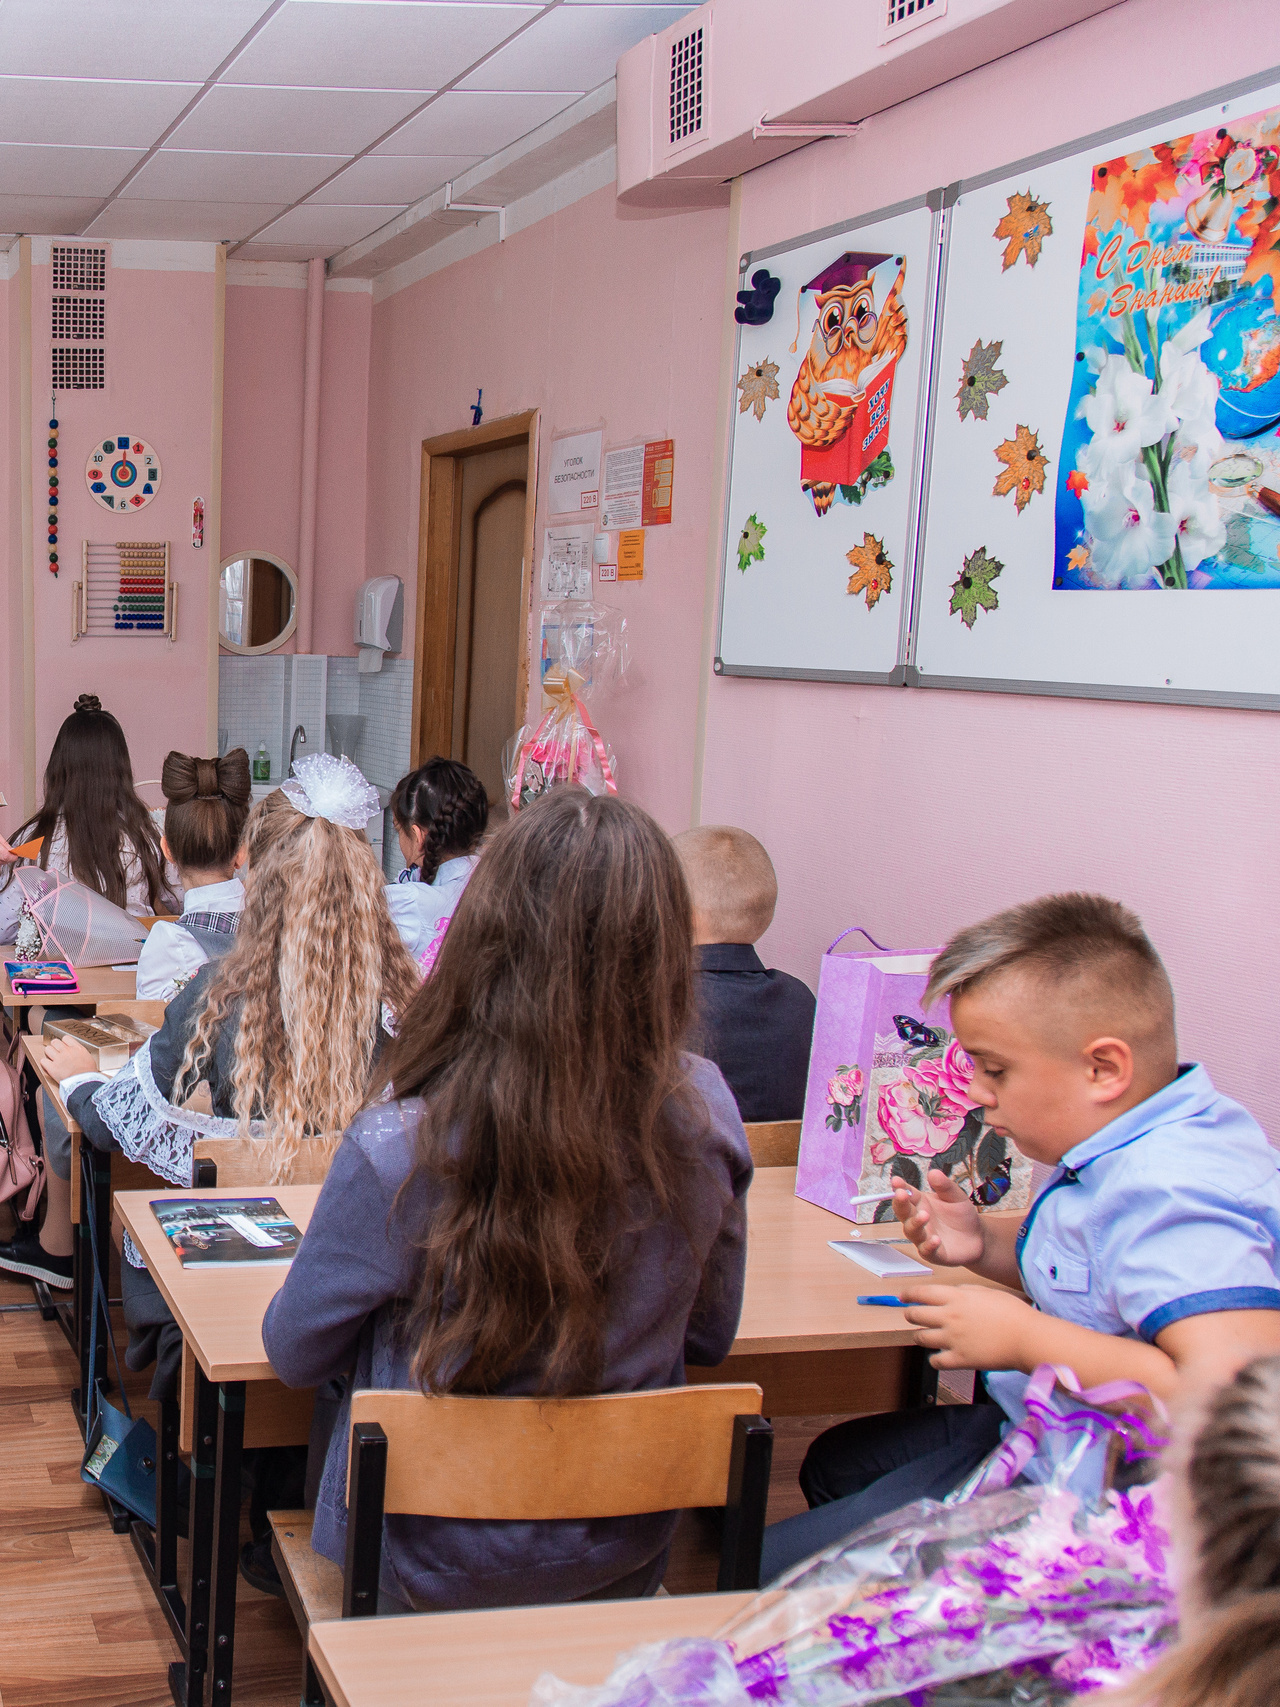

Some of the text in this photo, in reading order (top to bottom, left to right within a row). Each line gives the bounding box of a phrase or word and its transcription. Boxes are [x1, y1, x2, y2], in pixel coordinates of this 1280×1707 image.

[1095, 235, 1195, 281] С Днем
[1108, 265, 1221, 319] Знаний!
[867, 378, 891, 413] ХОЧУ
[861, 410, 890, 452] ЗНАТЬ!
[136, 444, 141, 452] 1
[563, 457, 583, 468] УГОЛОК
[554, 469, 595, 484] БЕЗОПАСНОСТИ
[121, 500, 126, 508] 6
[583, 495, 592, 504] 220
[592, 495, 597, 503] В
[601, 569, 610, 577] 220
[610, 568, 615, 577] В
